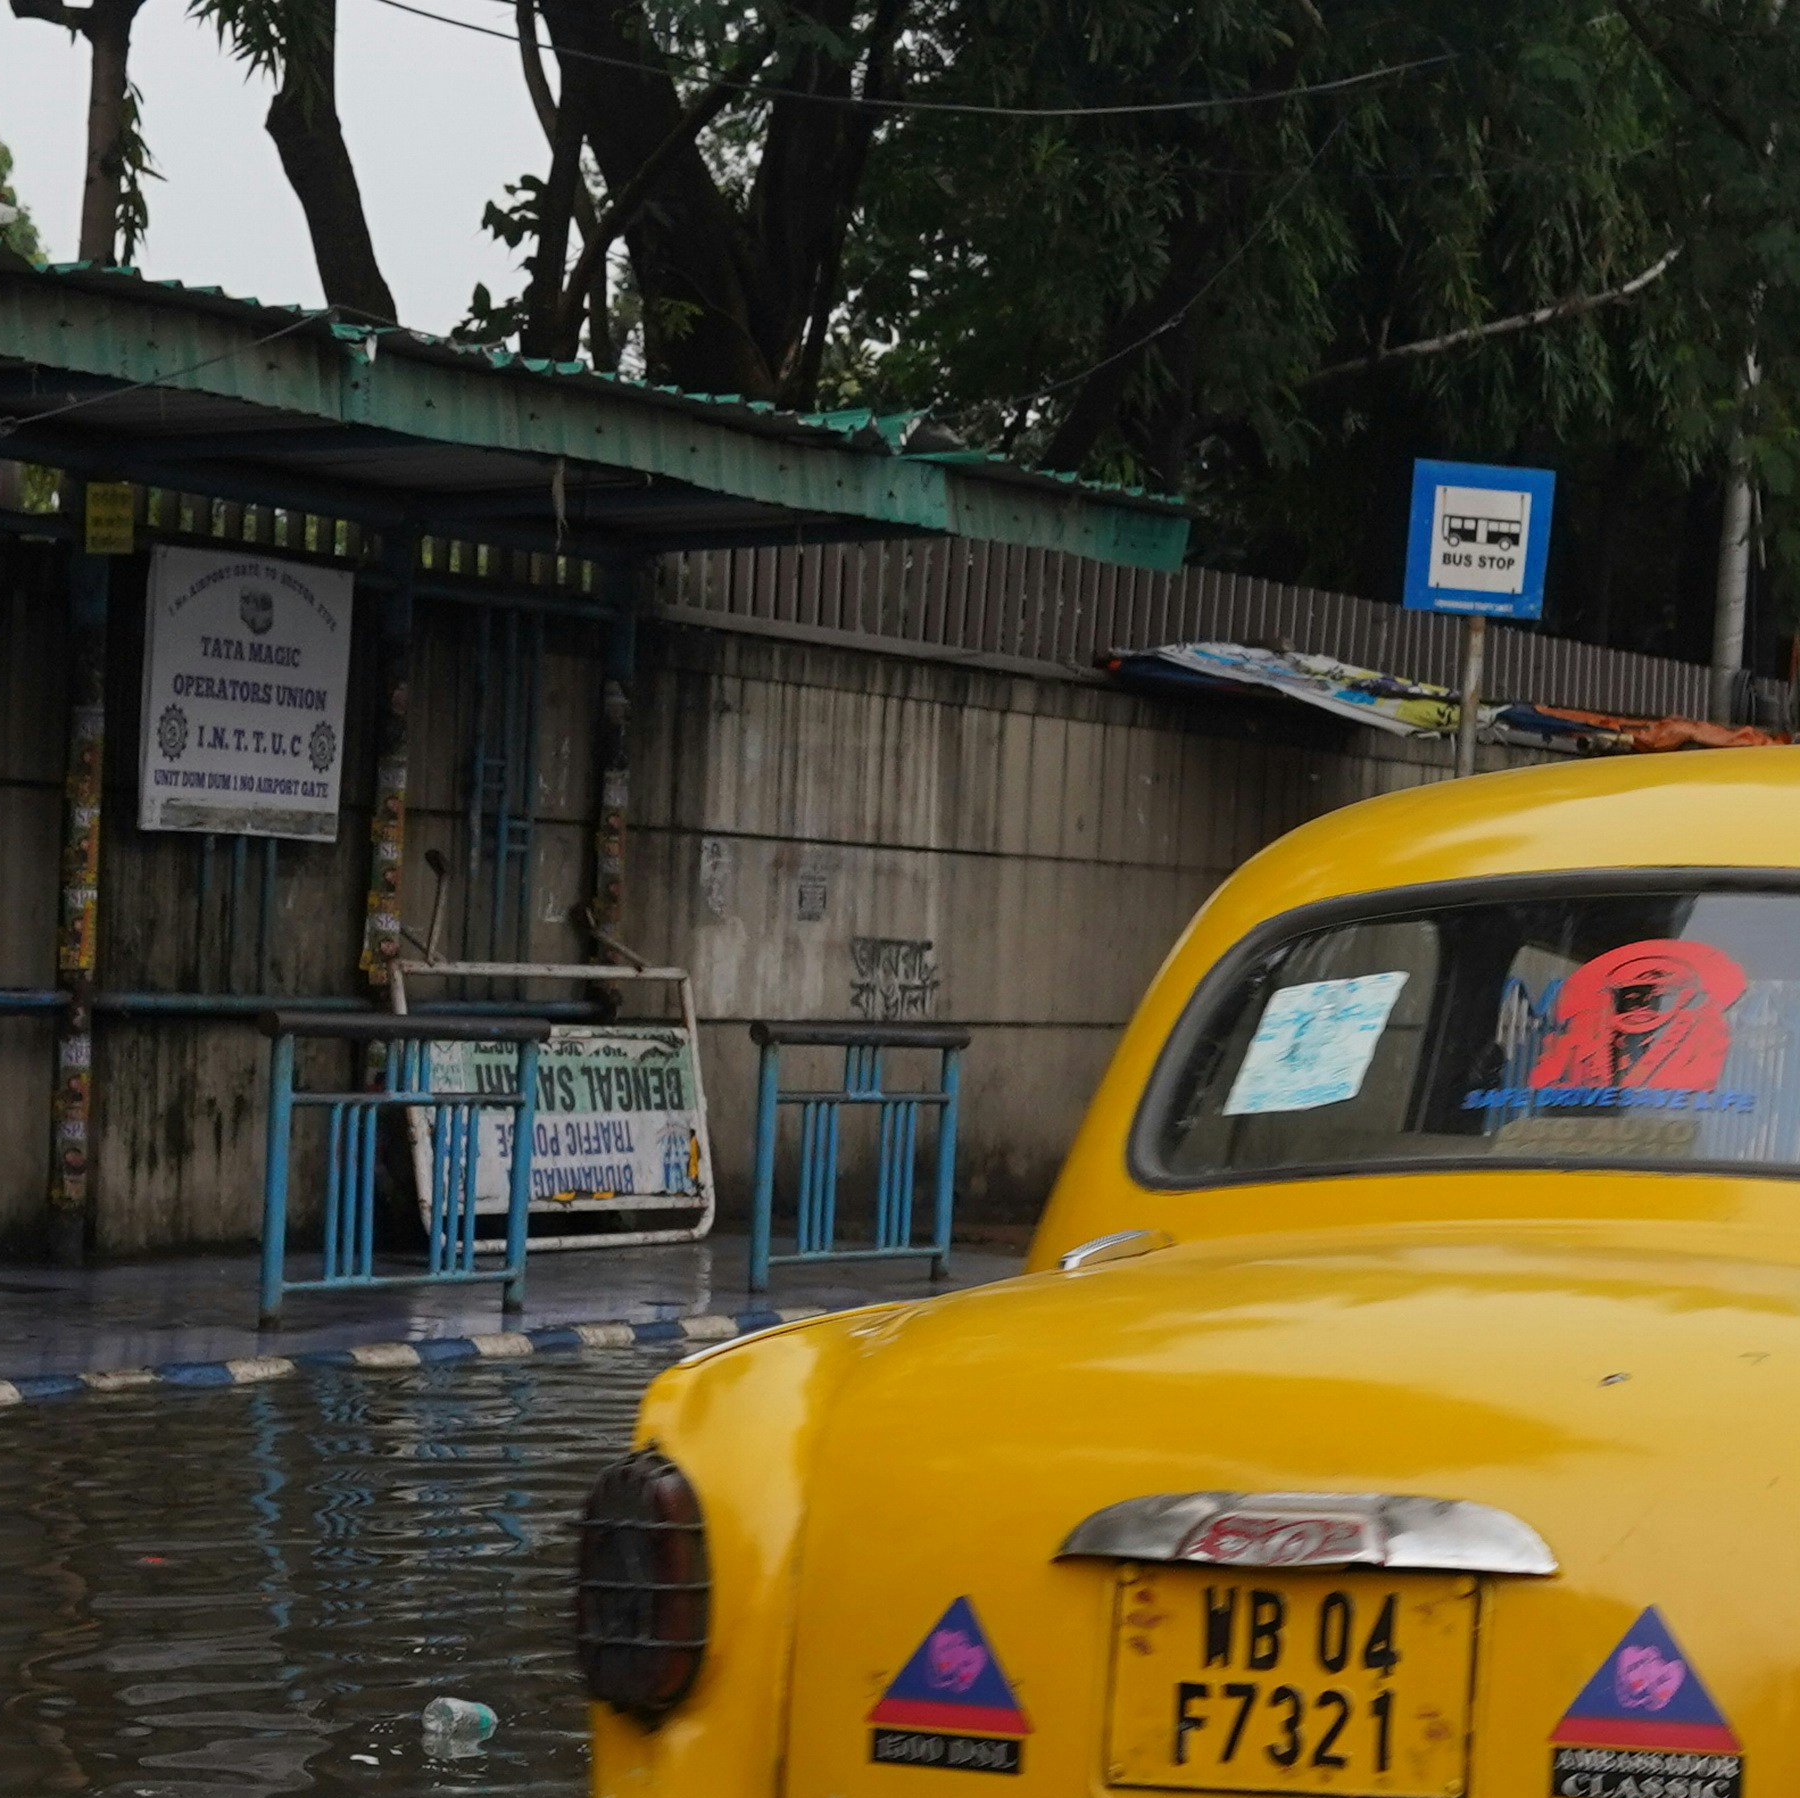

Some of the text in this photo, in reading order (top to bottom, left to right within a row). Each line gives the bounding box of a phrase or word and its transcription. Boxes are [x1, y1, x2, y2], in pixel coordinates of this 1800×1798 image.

[1443, 553, 1515, 570] BUS STOP
[201, 636, 301, 668] TATA MAGIC
[173, 673, 327, 711] OPERATORS UNION
[154, 770, 180, 787] UNIT
[182, 771, 205, 789] DUM
[208, 773, 231, 790] DUM
[240, 775, 255, 792] NO
[255, 776, 300, 796] AIRPORT
[301, 781, 329, 798] GATE
[582, 1065, 684, 1111] BENGAL
[1460, 1086, 1756, 1113] SAFE DRIVE SAVE LIFE
[567, 1121, 634, 1157] TRAFFIC
[1204, 1586, 1400, 1677] WB 04
[1174, 1682, 1396, 1772] F7321
[1555, 1747, 1741, 1779] AMBASSADOR
